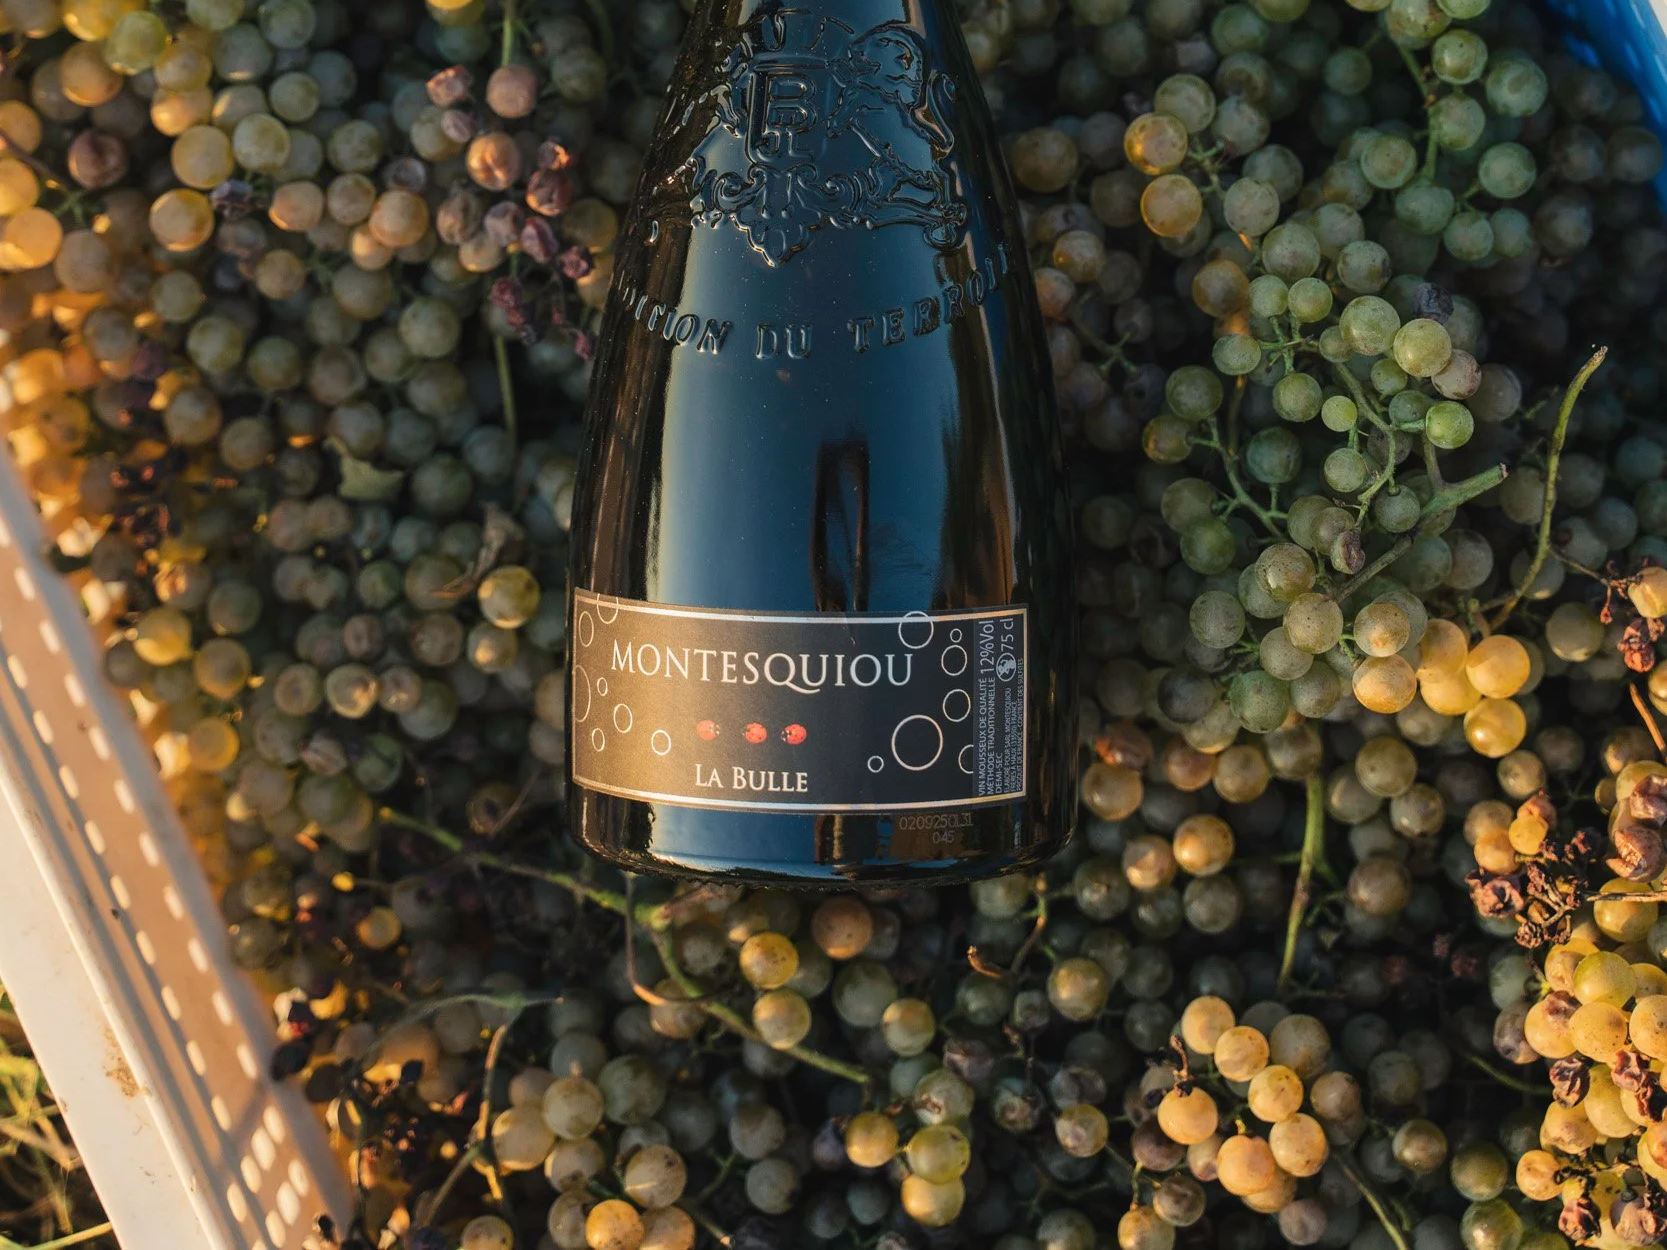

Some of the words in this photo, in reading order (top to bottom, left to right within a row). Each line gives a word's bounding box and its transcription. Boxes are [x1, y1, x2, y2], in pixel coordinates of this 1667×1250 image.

[756, 322, 813, 360] DU
[1000, 618, 1013, 629] cl
[979, 620, 994, 674] 12%Vol
[1001, 633, 1013, 651] 75
[611, 639, 913, 694] MONTESQUIOU
[979, 678, 987, 714] QUALITÉ
[980, 716, 986, 728] DE
[695, 764, 724, 788] LA
[732, 767, 808, 793] BULLE
[986, 751, 994, 794] MÉTHODE
